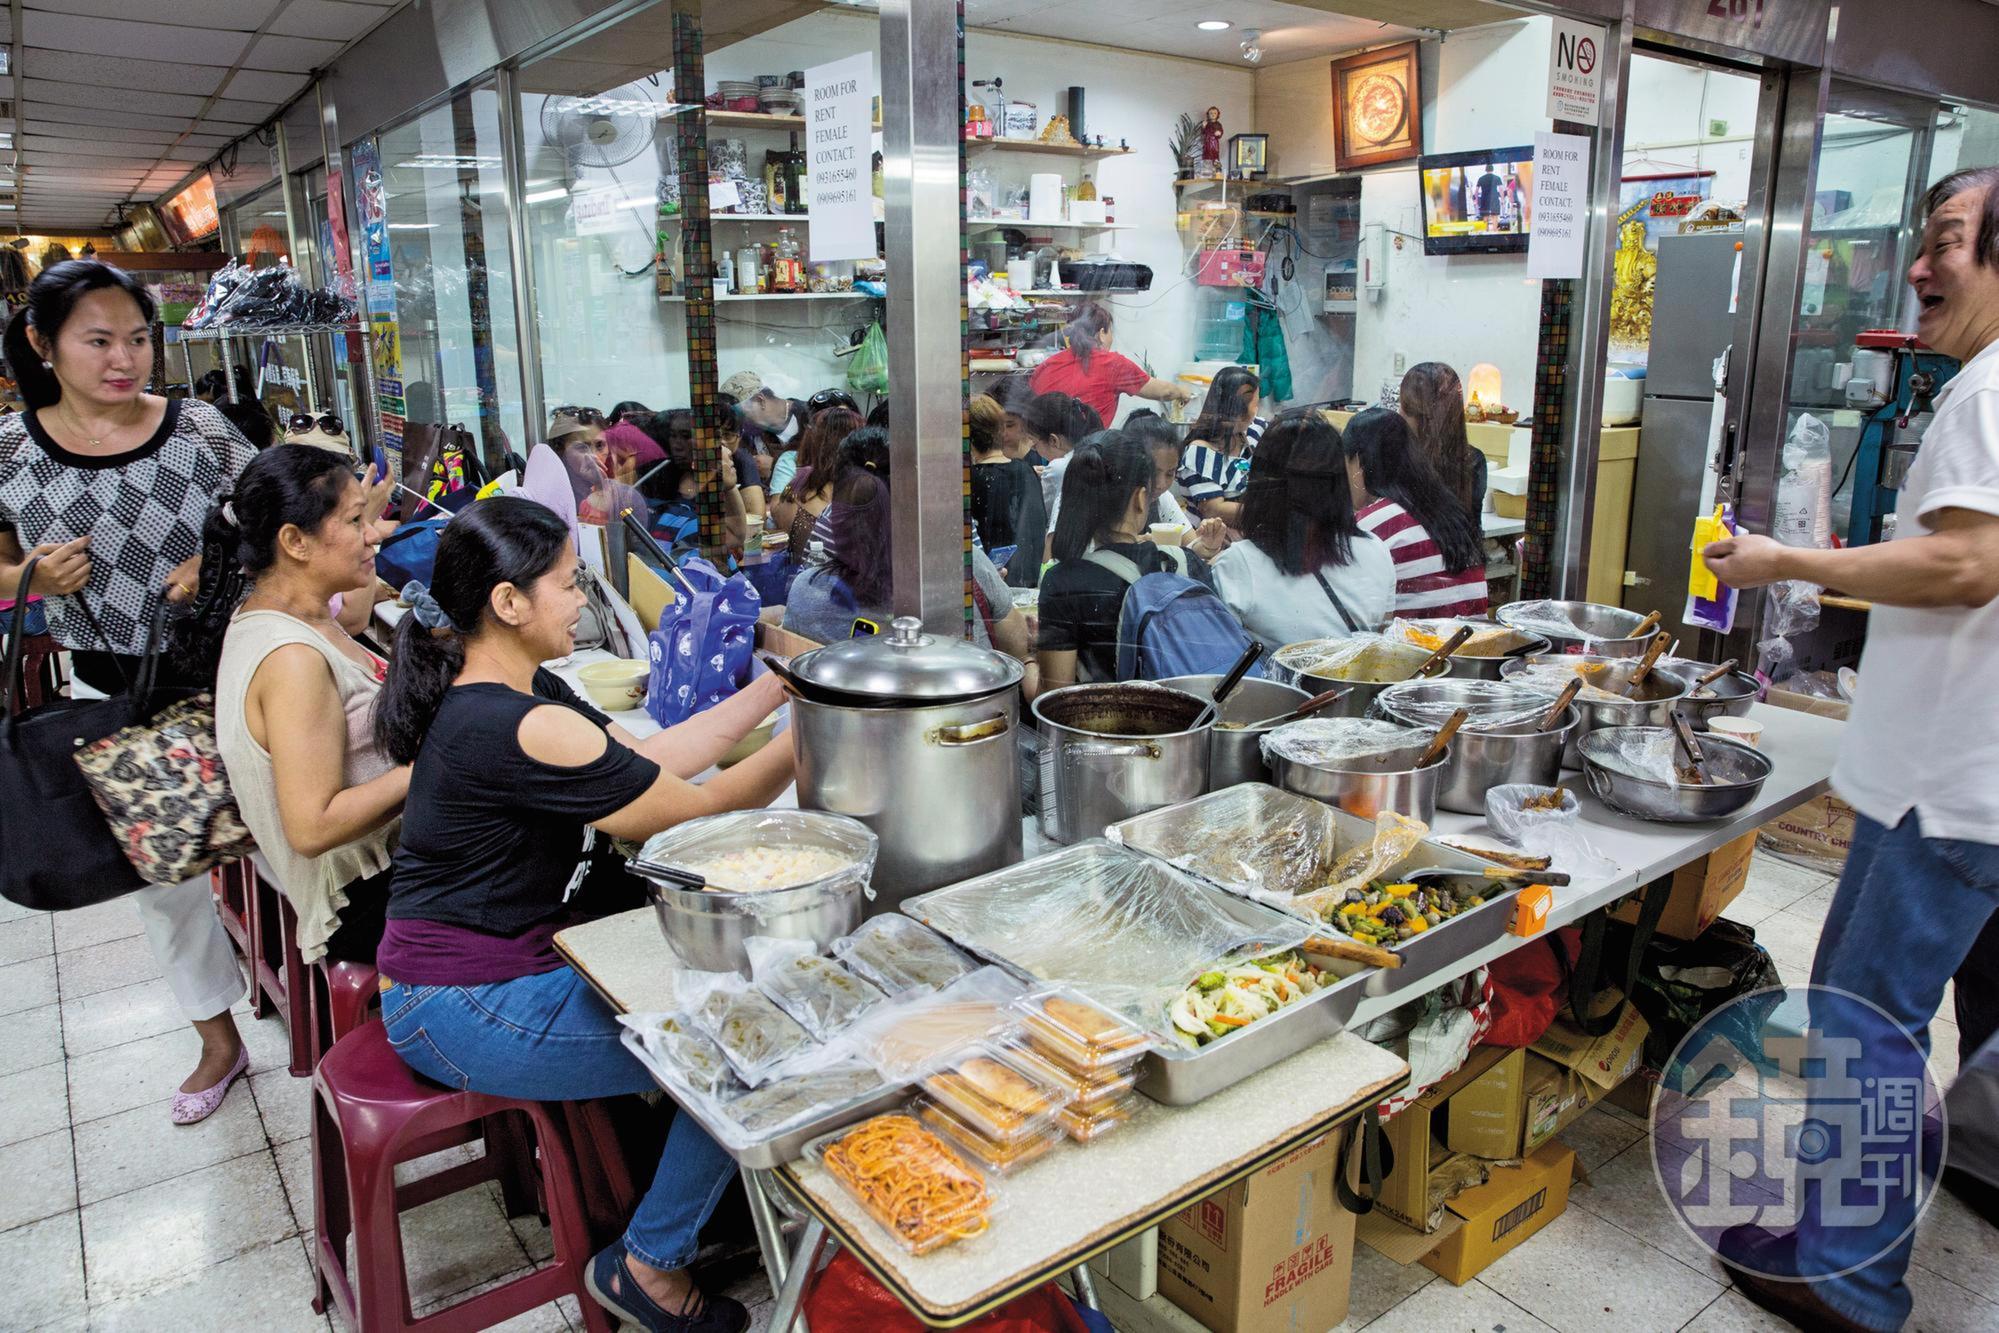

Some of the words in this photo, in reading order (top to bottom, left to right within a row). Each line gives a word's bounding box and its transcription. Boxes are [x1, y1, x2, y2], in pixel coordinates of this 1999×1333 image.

[1556, 72, 1594, 88] SMOKING
[814, 84, 839, 101] ROOM
[840, 80, 857, 96] FOR
[815, 106, 836, 122] RENT
[815, 125, 848, 143] FEMALE
[815, 146, 856, 164] CONTACT:
[1543, 149, 1563, 161] ROOM
[1565, 151, 1578, 161] FOR
[1541, 165, 1560, 176] RENT
[1540, 181, 1568, 192] FEMALE
[1539, 196, 1573, 208] CONTACT:
[1778, 821, 1828, 843] COUNTRY
[1264, 1244, 1333, 1298] FRAGILE
[1263, 1282, 1294, 1308] HANDLE
[1295, 1270, 1314, 1287] WITH
[1314, 1257, 1333, 1274] CARE
